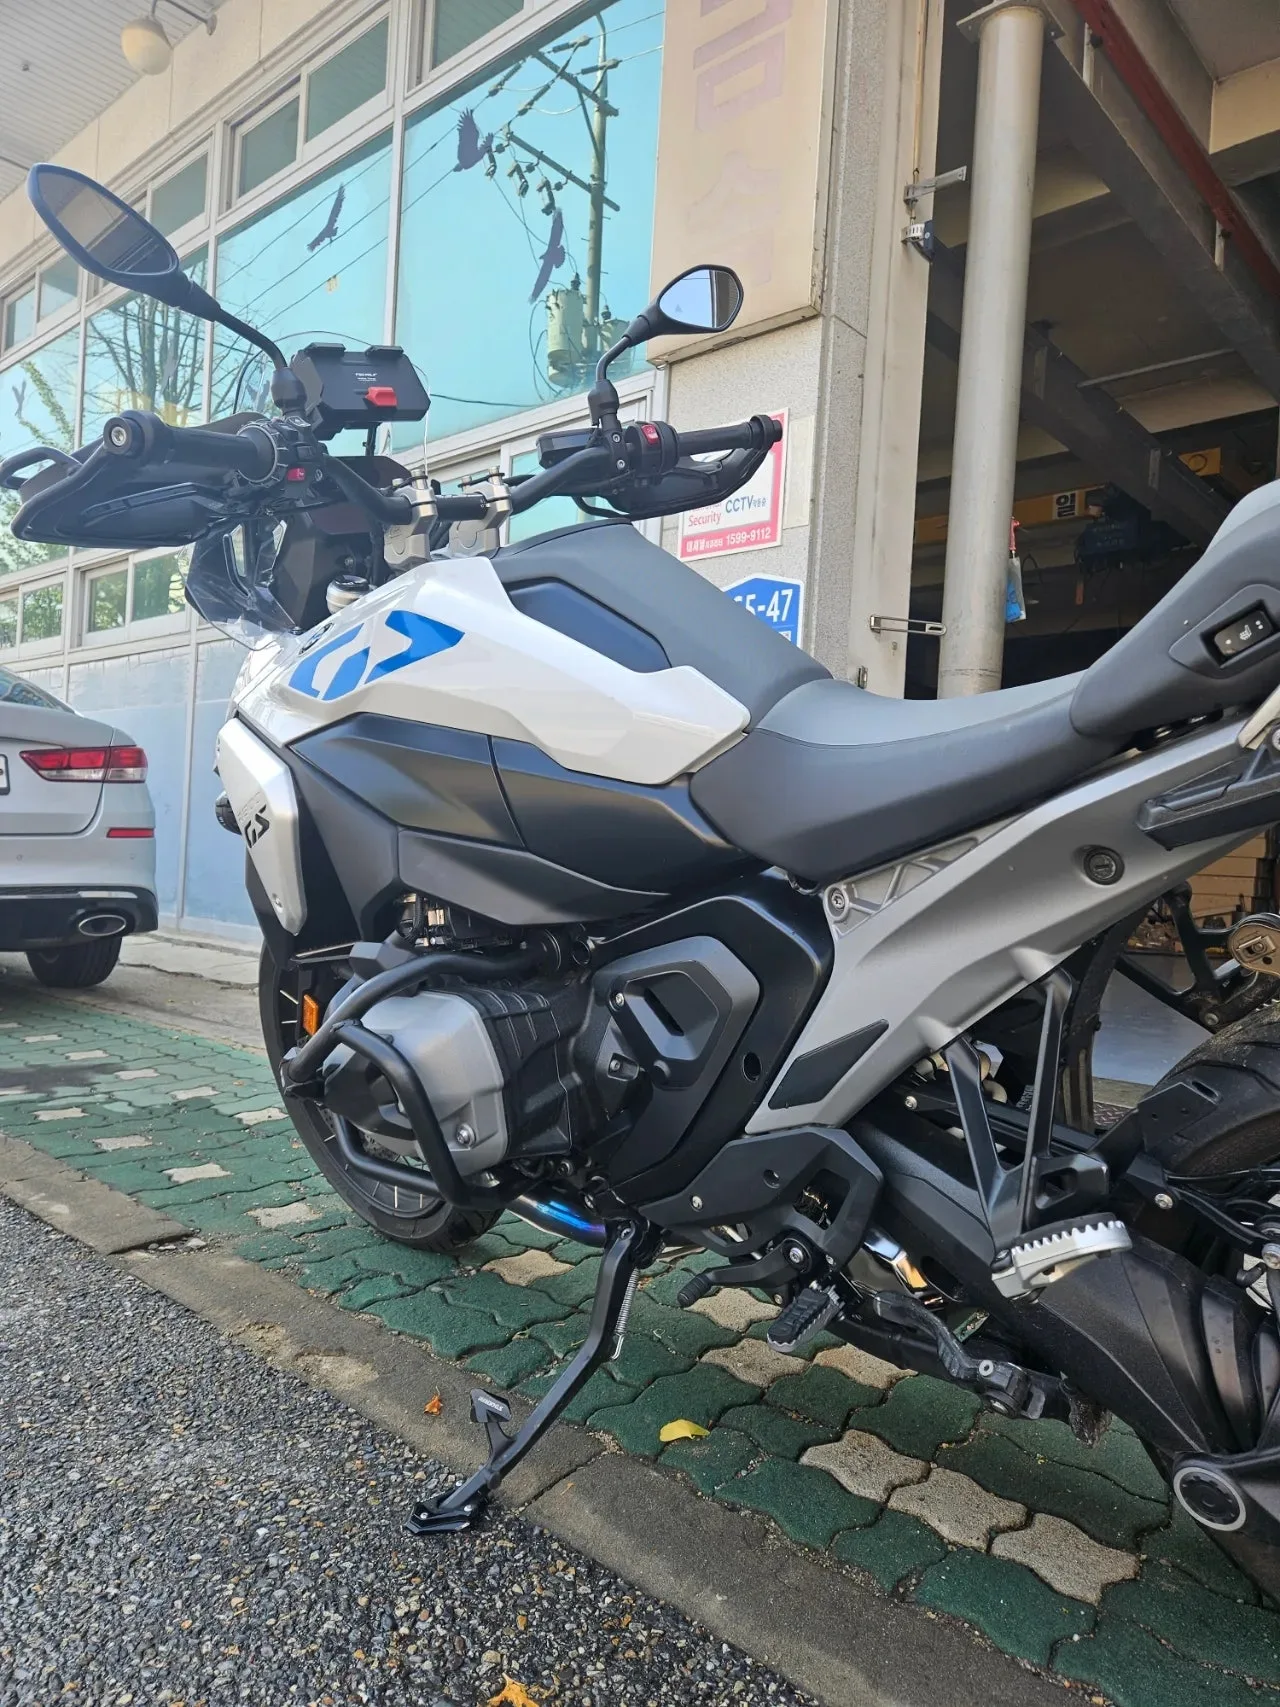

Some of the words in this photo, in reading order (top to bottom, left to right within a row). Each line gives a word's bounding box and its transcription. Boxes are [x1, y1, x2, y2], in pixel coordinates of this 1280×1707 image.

[725, 494, 754, 514] CCTV
[688, 511, 722, 527] Security
[726, 527, 772, 546] 1599-9112
[733, 588, 793, 623] 5-47
